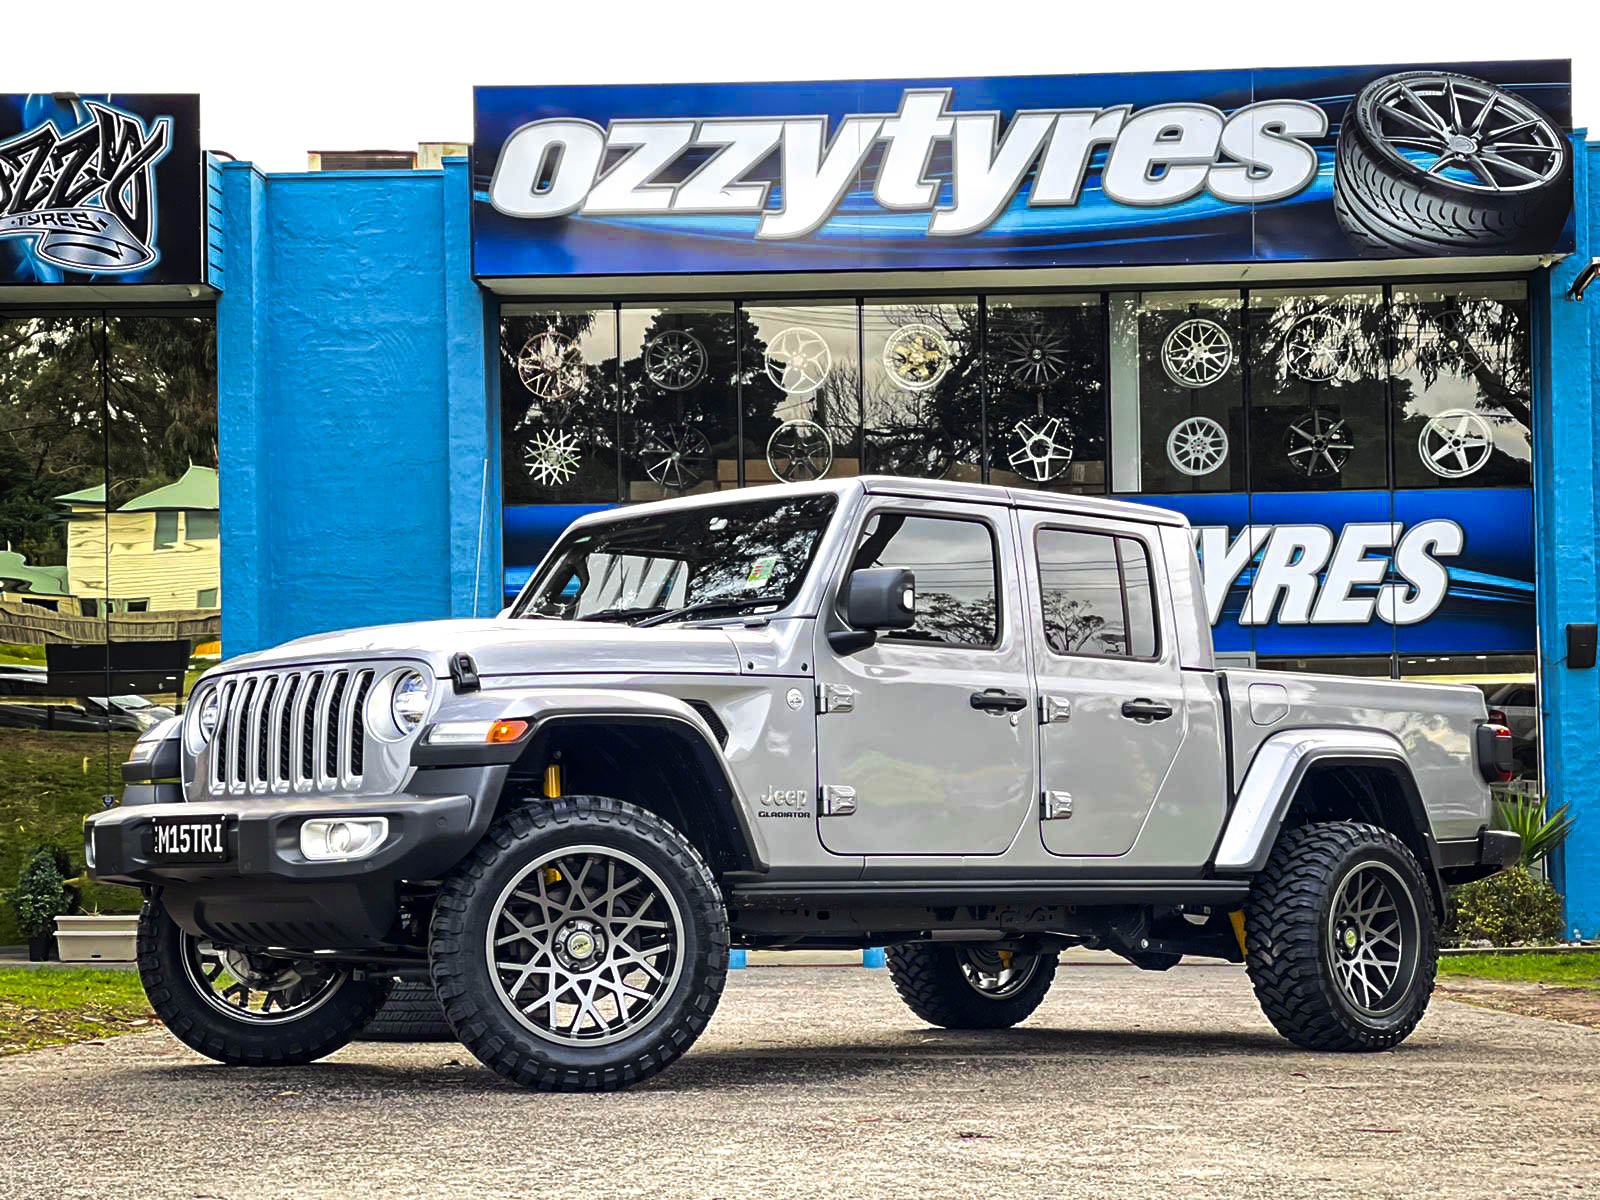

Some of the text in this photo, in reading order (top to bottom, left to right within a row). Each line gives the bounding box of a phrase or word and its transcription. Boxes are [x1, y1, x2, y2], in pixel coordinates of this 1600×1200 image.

[0, 101, 169, 249] ZZY
[488, 87, 1328, 240] ozzytyres
[17, 211, 101, 232] TYRES
[1190, 518, 1464, 626] YRES
[760, 784, 808, 809] Jeep
[758, 810, 811, 819] GLADIATOR
[158, 824, 223, 853] M15TRI
